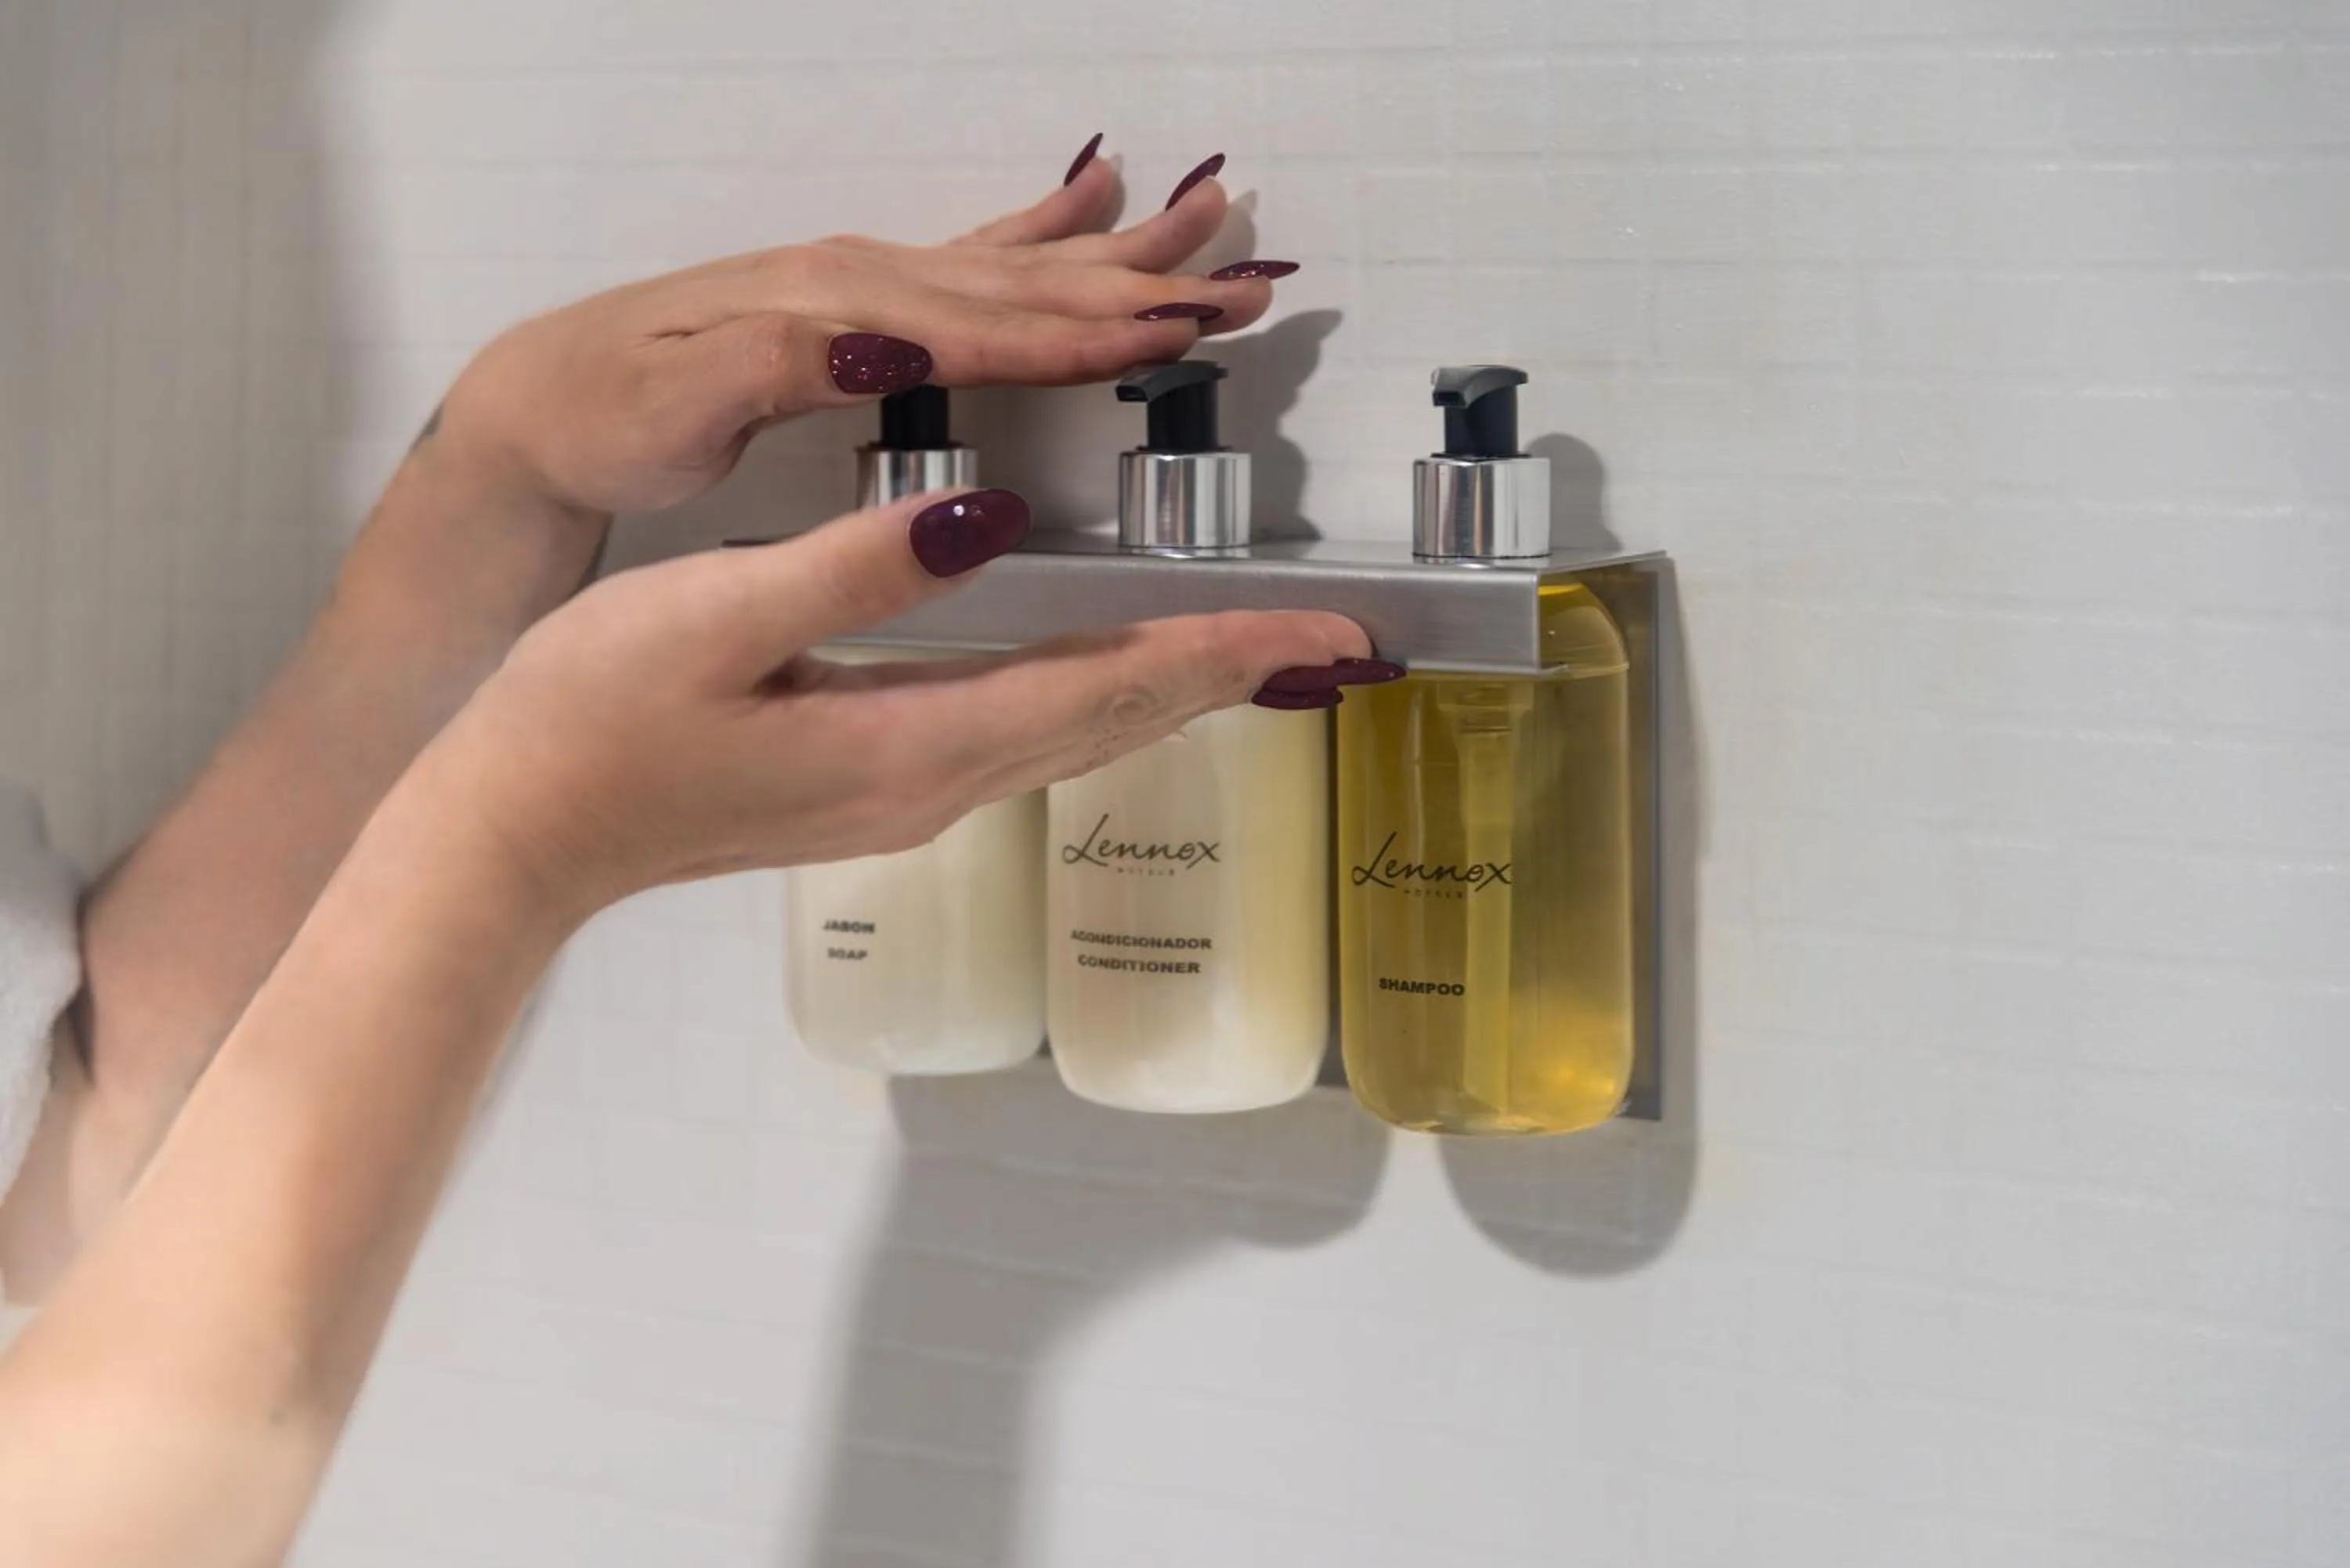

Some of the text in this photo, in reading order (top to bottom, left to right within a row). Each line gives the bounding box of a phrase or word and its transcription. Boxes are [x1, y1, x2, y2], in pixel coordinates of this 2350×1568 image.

[1062, 813, 1220, 870] Lennox
[1352, 831, 1513, 892] Lennox
[1070, 930, 1213, 949] ACONDICIONADOR
[827, 947, 868, 960] SOAP
[1077, 954, 1202, 974] CONDITIONER
[1379, 977, 1465, 996] SHAMPOO
